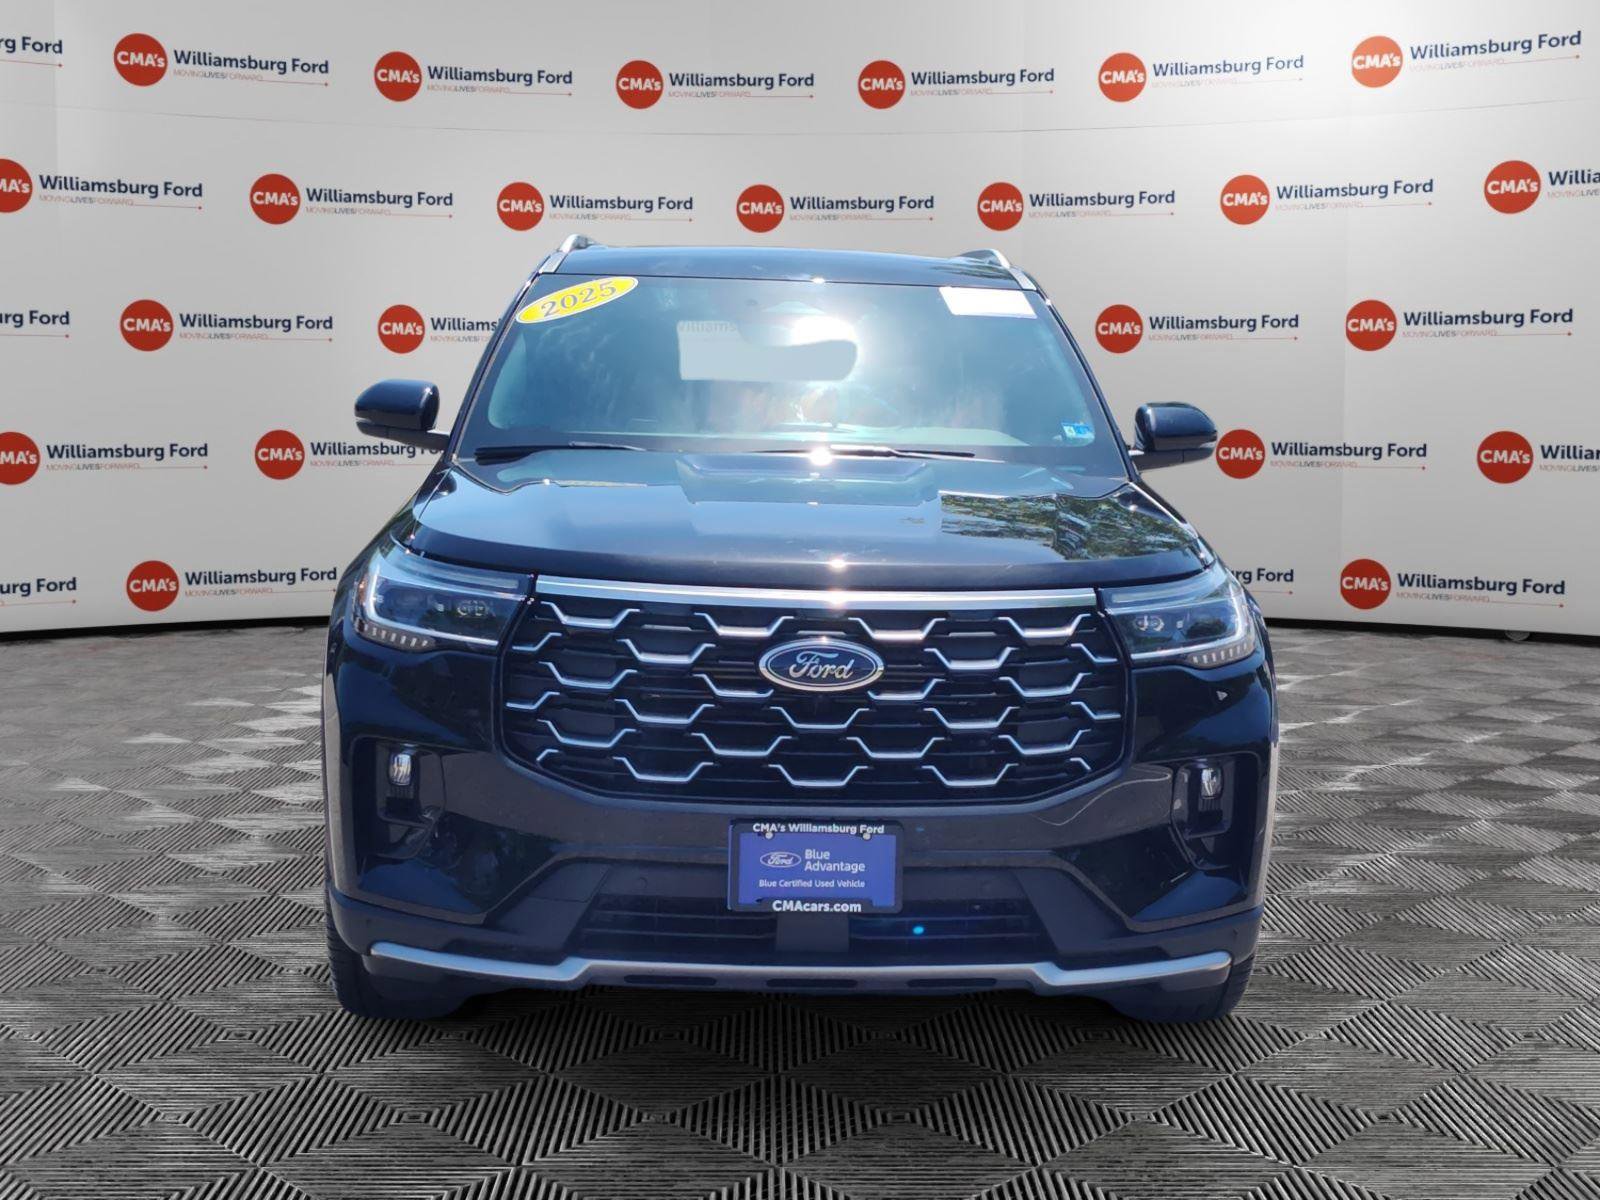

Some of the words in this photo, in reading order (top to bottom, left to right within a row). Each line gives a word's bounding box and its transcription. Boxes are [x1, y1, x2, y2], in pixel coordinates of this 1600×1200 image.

[21, 36, 63, 54] Ford
[1353, 53, 1401, 70] CMA's
[1410, 39, 1533, 60] Williamsburg
[1537, 30, 1582, 48] Ford
[117, 50, 165, 68] CMA's
[173, 49, 288, 75] Williamsburg
[291, 57, 330, 74] Ford
[1100, 68, 1146, 85] CMA's
[1152, 59, 1262, 77] Williamsburg
[1266, 54, 1304, 71] Ford
[376, 68, 421, 84] CMA's
[427, 66, 533, 87] Williamsburg
[536, 69, 573, 85] Ford
[618, 77, 662, 91] CMA's
[668, 73, 775, 91] Williamsburg
[778, 72, 815, 87] Ford
[860, 77, 904, 91] CMA's
[910, 71, 1016, 87] Williamsburg
[1019, 67, 1055, 83] Ford
[38, 174, 159, 200] Williamsburg
[163, 181, 203, 198] Ford
[1223, 191, 1269, 207] CMA's
[1276, 182, 1389, 200] Williamsburg
[1393, 179, 1434, 195] Ford
[1487, 178, 1538, 195] CMA's
[252, 191, 299, 206] CMA's
[305, 187, 413, 207] Williamsburg
[417, 191, 453, 207] Ford
[499, 199, 543, 213] CMA's
[549, 194, 654, 214] Williamsburg
[657, 196, 694, 211] Ford
[738, 201, 783, 215] CMA's
[789, 195, 895, 214] Williamsburg
[898, 195, 935, 210] Ford
[980, 199, 1023, 213] CMA's
[1028, 191, 1135, 209] Williamsburg
[1138, 190, 1176, 205] Ford
[541, 281, 617, 317] 2025
[28, 310, 71, 325] Ford
[123, 318, 171, 332] CMA's
[178, 312, 292, 333] Williamsburg
[295, 315, 334, 330] Ford
[380, 321, 423, 335] CMA's
[430, 317, 501, 331] Williams
[1097, 320, 1141, 335] CMA's
[1148, 315, 1258, 333] Williamsburg
[1261, 313, 1299, 329] Ford
[1347, 317, 1395, 333] CMA's
[1403, 309, 1525, 328] Williamsburg
[1529, 307, 1574, 324] Ford
[45, 443, 165, 462] Williamsburg
[169, 442, 209, 458] Ford
[257, 447, 303, 461] CMA's
[310, 441, 416, 458] Williamsburg
[1218, 446, 1263, 461] CMA's
[1270, 441, 1383, 461] Williamsburg
[1387, 442, 1428, 458] Ford
[1480, 449, 1530, 464] CMA's
[1540, 444, 1600, 460] Willia
[35, 576, 78, 593] Ford
[129, 578, 177, 593] CMA's
[184, 568, 297, 587] Williamsburg
[300, 567, 338, 582] Ford
[1256, 567, 1295, 583] Ford
[1342, 575, 1388, 591] CMA's
[1396, 572, 1518, 596] Williamsburg
[1522, 578, 1566, 595] Ford
[788, 650, 855, 679] Ford
[753, 823, 786, 834] CMA's
[788, 823, 857, 835] Williamsburg
[859, 824, 885, 835] Ford
[804, 849, 830, 861] Blue
[804, 861, 866, 875] Advantage
[759, 879, 777, 888] Blue
[779, 879, 813, 888] Certified
[815, 879, 835, 888] Used
[837, 879, 866, 888] Vehicle
[772, 900, 862, 913] CMAcars.com
